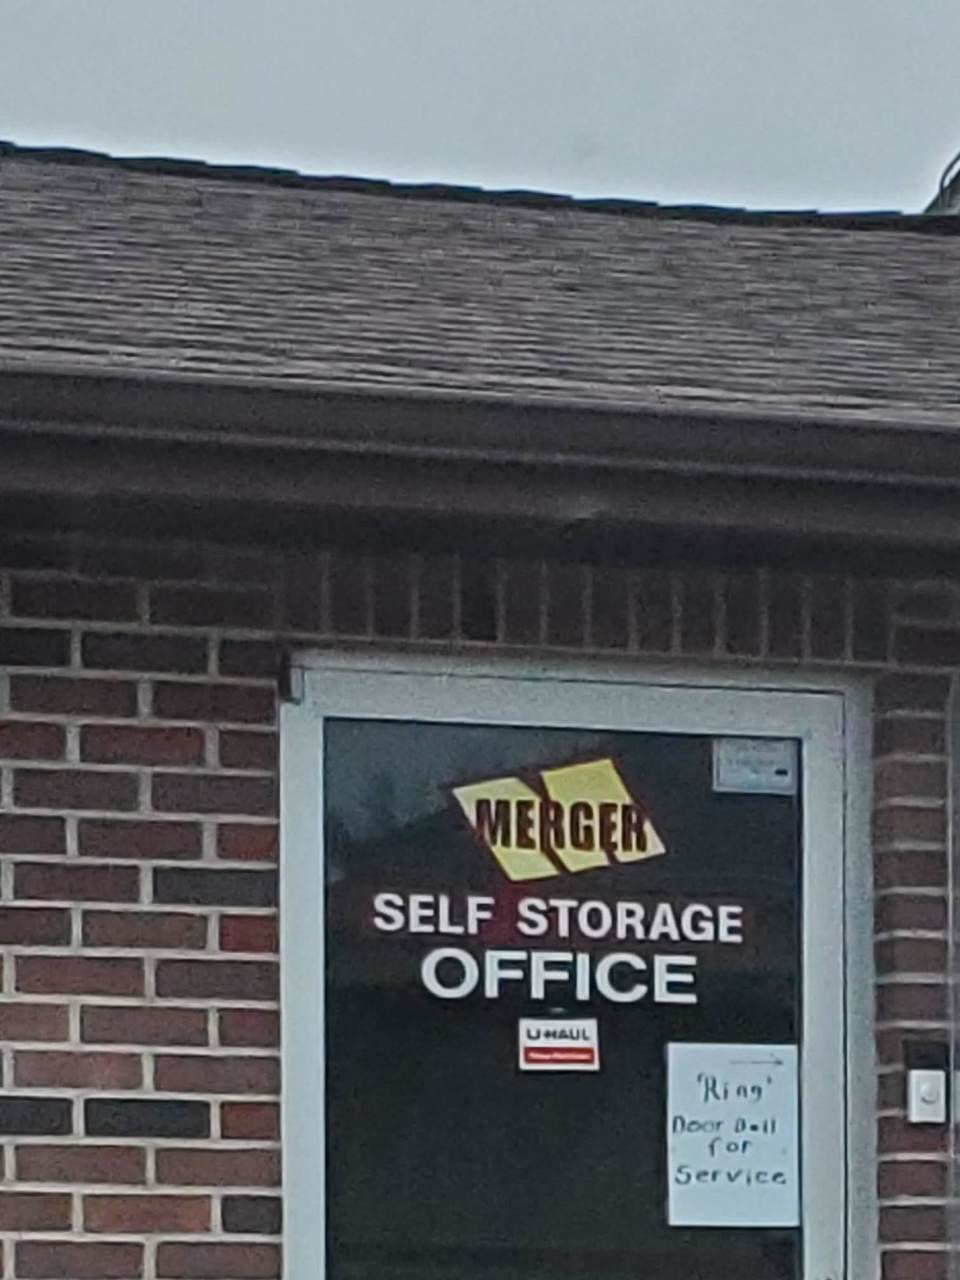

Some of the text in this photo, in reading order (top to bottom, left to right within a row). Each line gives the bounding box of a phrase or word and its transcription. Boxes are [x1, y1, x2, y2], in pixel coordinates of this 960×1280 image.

[475, 798, 648, 853] MERGER
[373, 893, 744, 944] SELF STORAGE
[420, 947, 698, 1005] OFFICE
[672, 1115, 723, 1135] Door
[708, 1137, 752, 1157] for
[674, 1164, 787, 1186] Service
